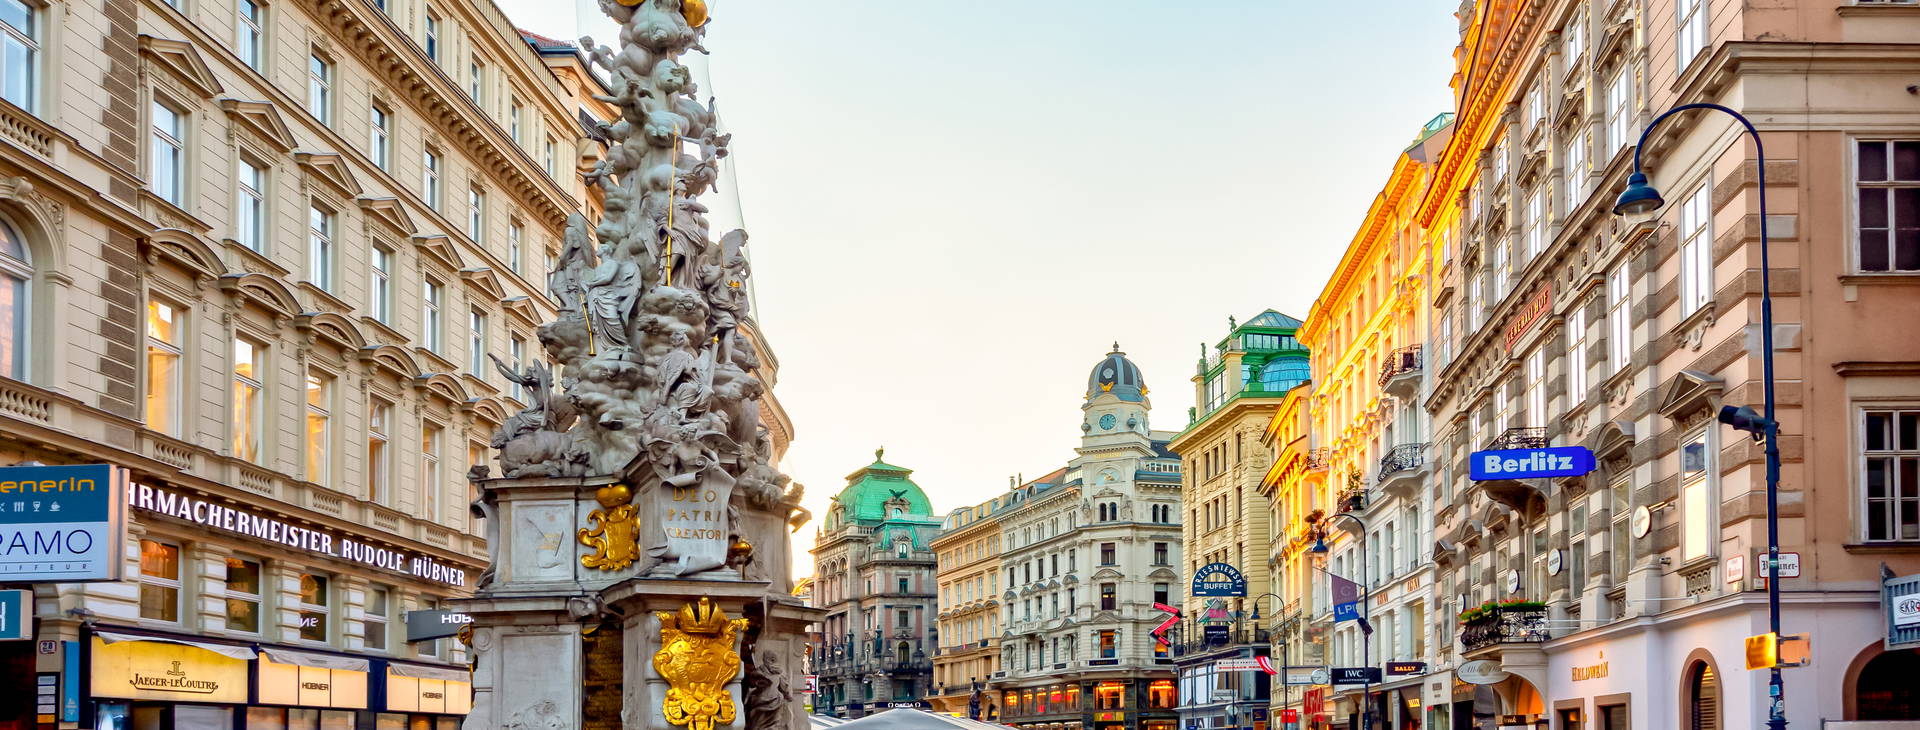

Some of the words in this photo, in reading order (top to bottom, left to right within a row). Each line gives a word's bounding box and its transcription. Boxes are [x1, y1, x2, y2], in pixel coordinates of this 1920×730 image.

[1484, 451, 1574, 474] Berlitz
[673, 487, 717, 503] DEO
[667, 508, 721, 522] PATRI
[342, 538, 405, 571] RUDOLF
[413, 556, 466, 587] HÜBNER
